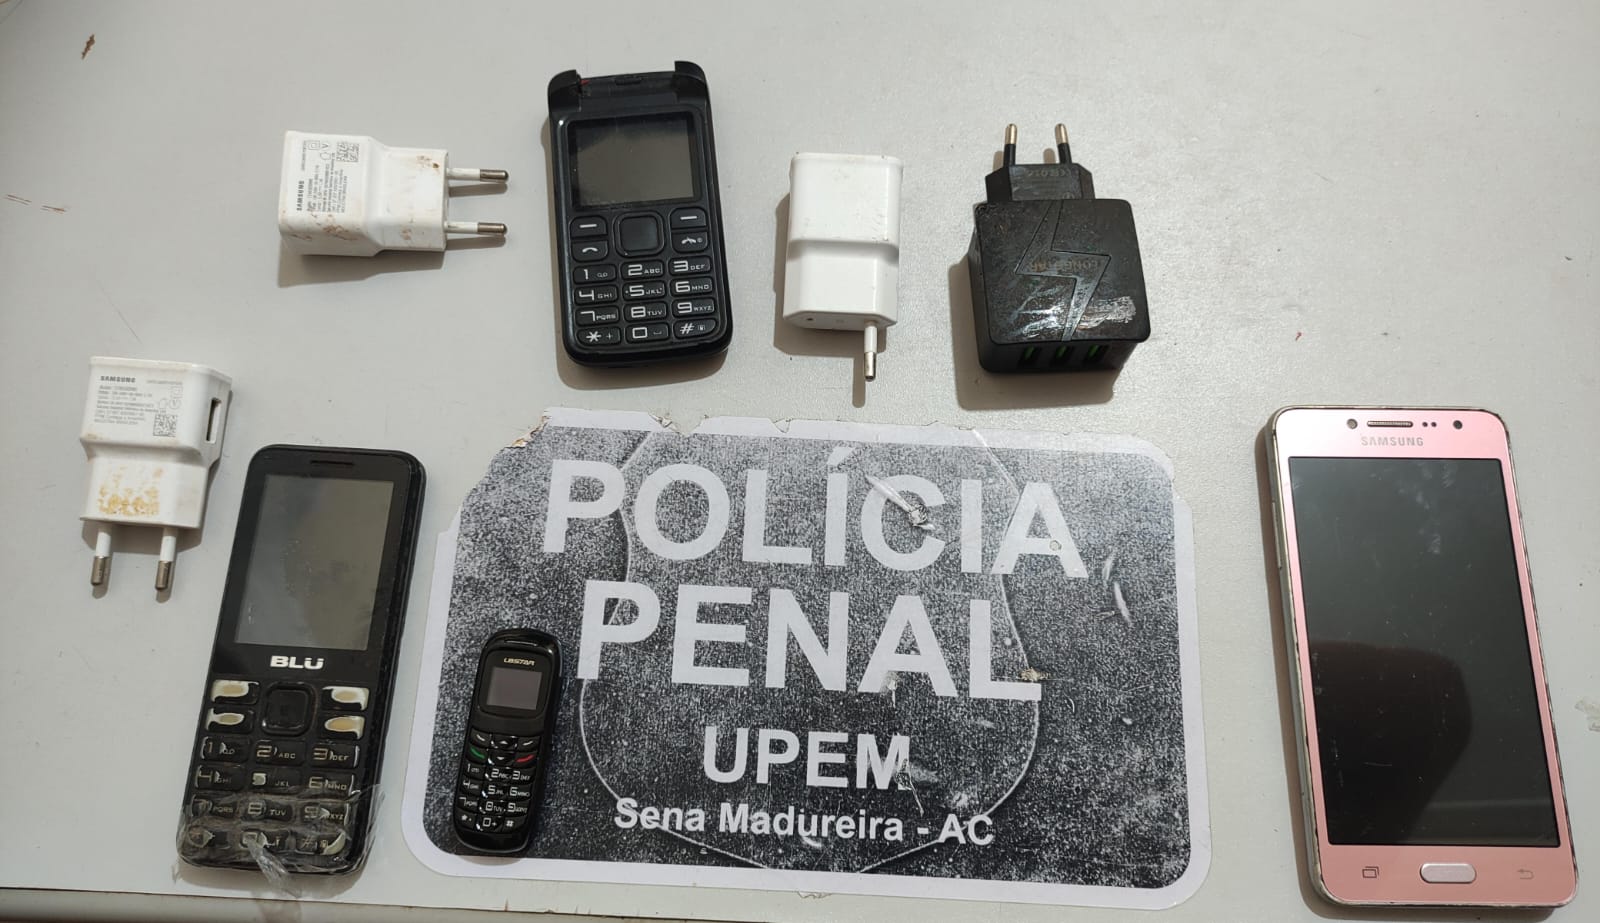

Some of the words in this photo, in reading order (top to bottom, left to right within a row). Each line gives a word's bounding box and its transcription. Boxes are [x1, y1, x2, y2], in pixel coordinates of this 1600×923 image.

[296, 180, 304, 211] SAMSUNG
[584, 268, 589, 280] 1
[628, 264, 643, 276] 2
[674, 260, 688, 272] 3
[579, 290, 595, 300] 4
[629, 285, 644, 297] 5
[675, 281, 690, 293] 6
[580, 311, 596, 322] 7
[631, 306, 646, 318] 8
[678, 302, 692, 314] 9
[1361, 436, 1424, 446] SAMSUNG
[544, 446, 1088, 578] POLÍCIA
[576, 580, 1042, 701] PENAL
[256, 745, 272, 758] 2
[313, 748, 328, 760] 3
[703, 725, 911, 791] UPEM
[309, 776, 323, 789] 6
[491, 768, 499, 778] 2
[512, 770, 521, 780] 3
[488, 785, 496, 795] 5
[510, 787, 518, 796] 6
[247, 802, 262, 814] 8
[459, 796, 466, 806] 7
[485, 801, 493, 811] 8
[507, 802, 516, 812] 9
[614, 797, 705, 832] Sena
[719, 802, 903, 841] Madureira
[938, 814, 994, 845] AC
